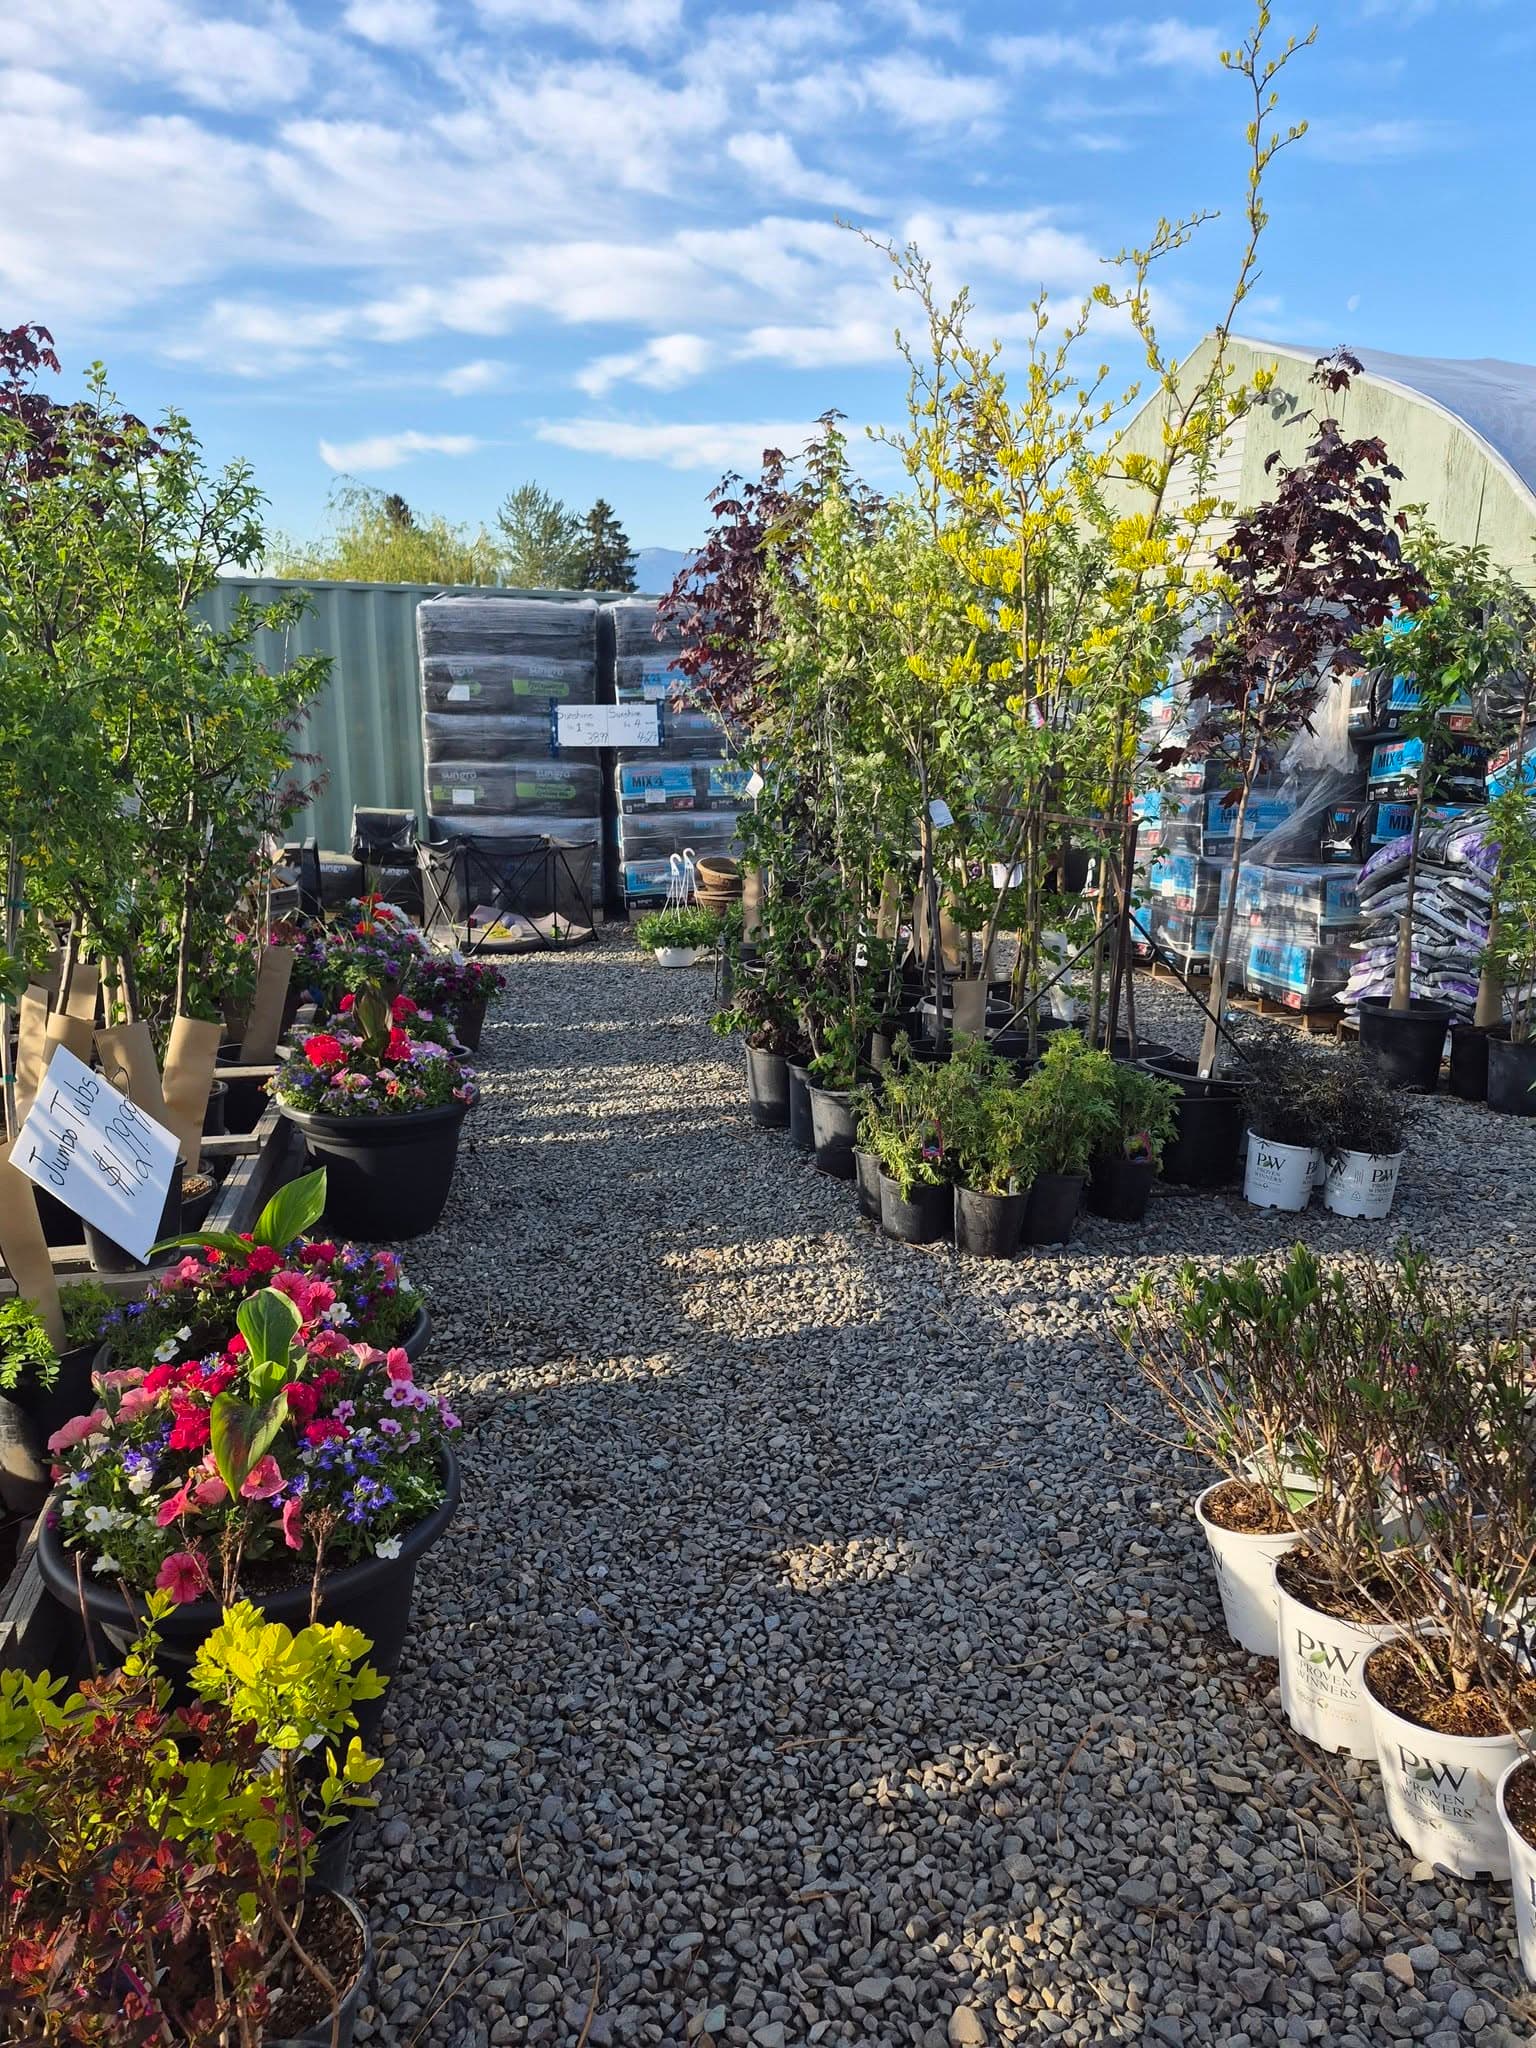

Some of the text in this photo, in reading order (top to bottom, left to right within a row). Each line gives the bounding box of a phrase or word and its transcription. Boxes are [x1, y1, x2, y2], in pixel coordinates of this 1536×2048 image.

[1378, 752, 1395, 768] MIX
[632, 776, 652, 787] MIX
[29, 1076, 101, 1187] Jumbo Tubs
[1296, 1628, 1360, 1675] PW
[1296, 1668, 1359, 1700] WINNERS
[1299, 1662, 1354, 1688] PROVEN
[1397, 1743, 1470, 1793] PW
[1401, 1786, 1474, 1819] WINNERS
[1405, 1778, 1466, 1806] PROVEN
